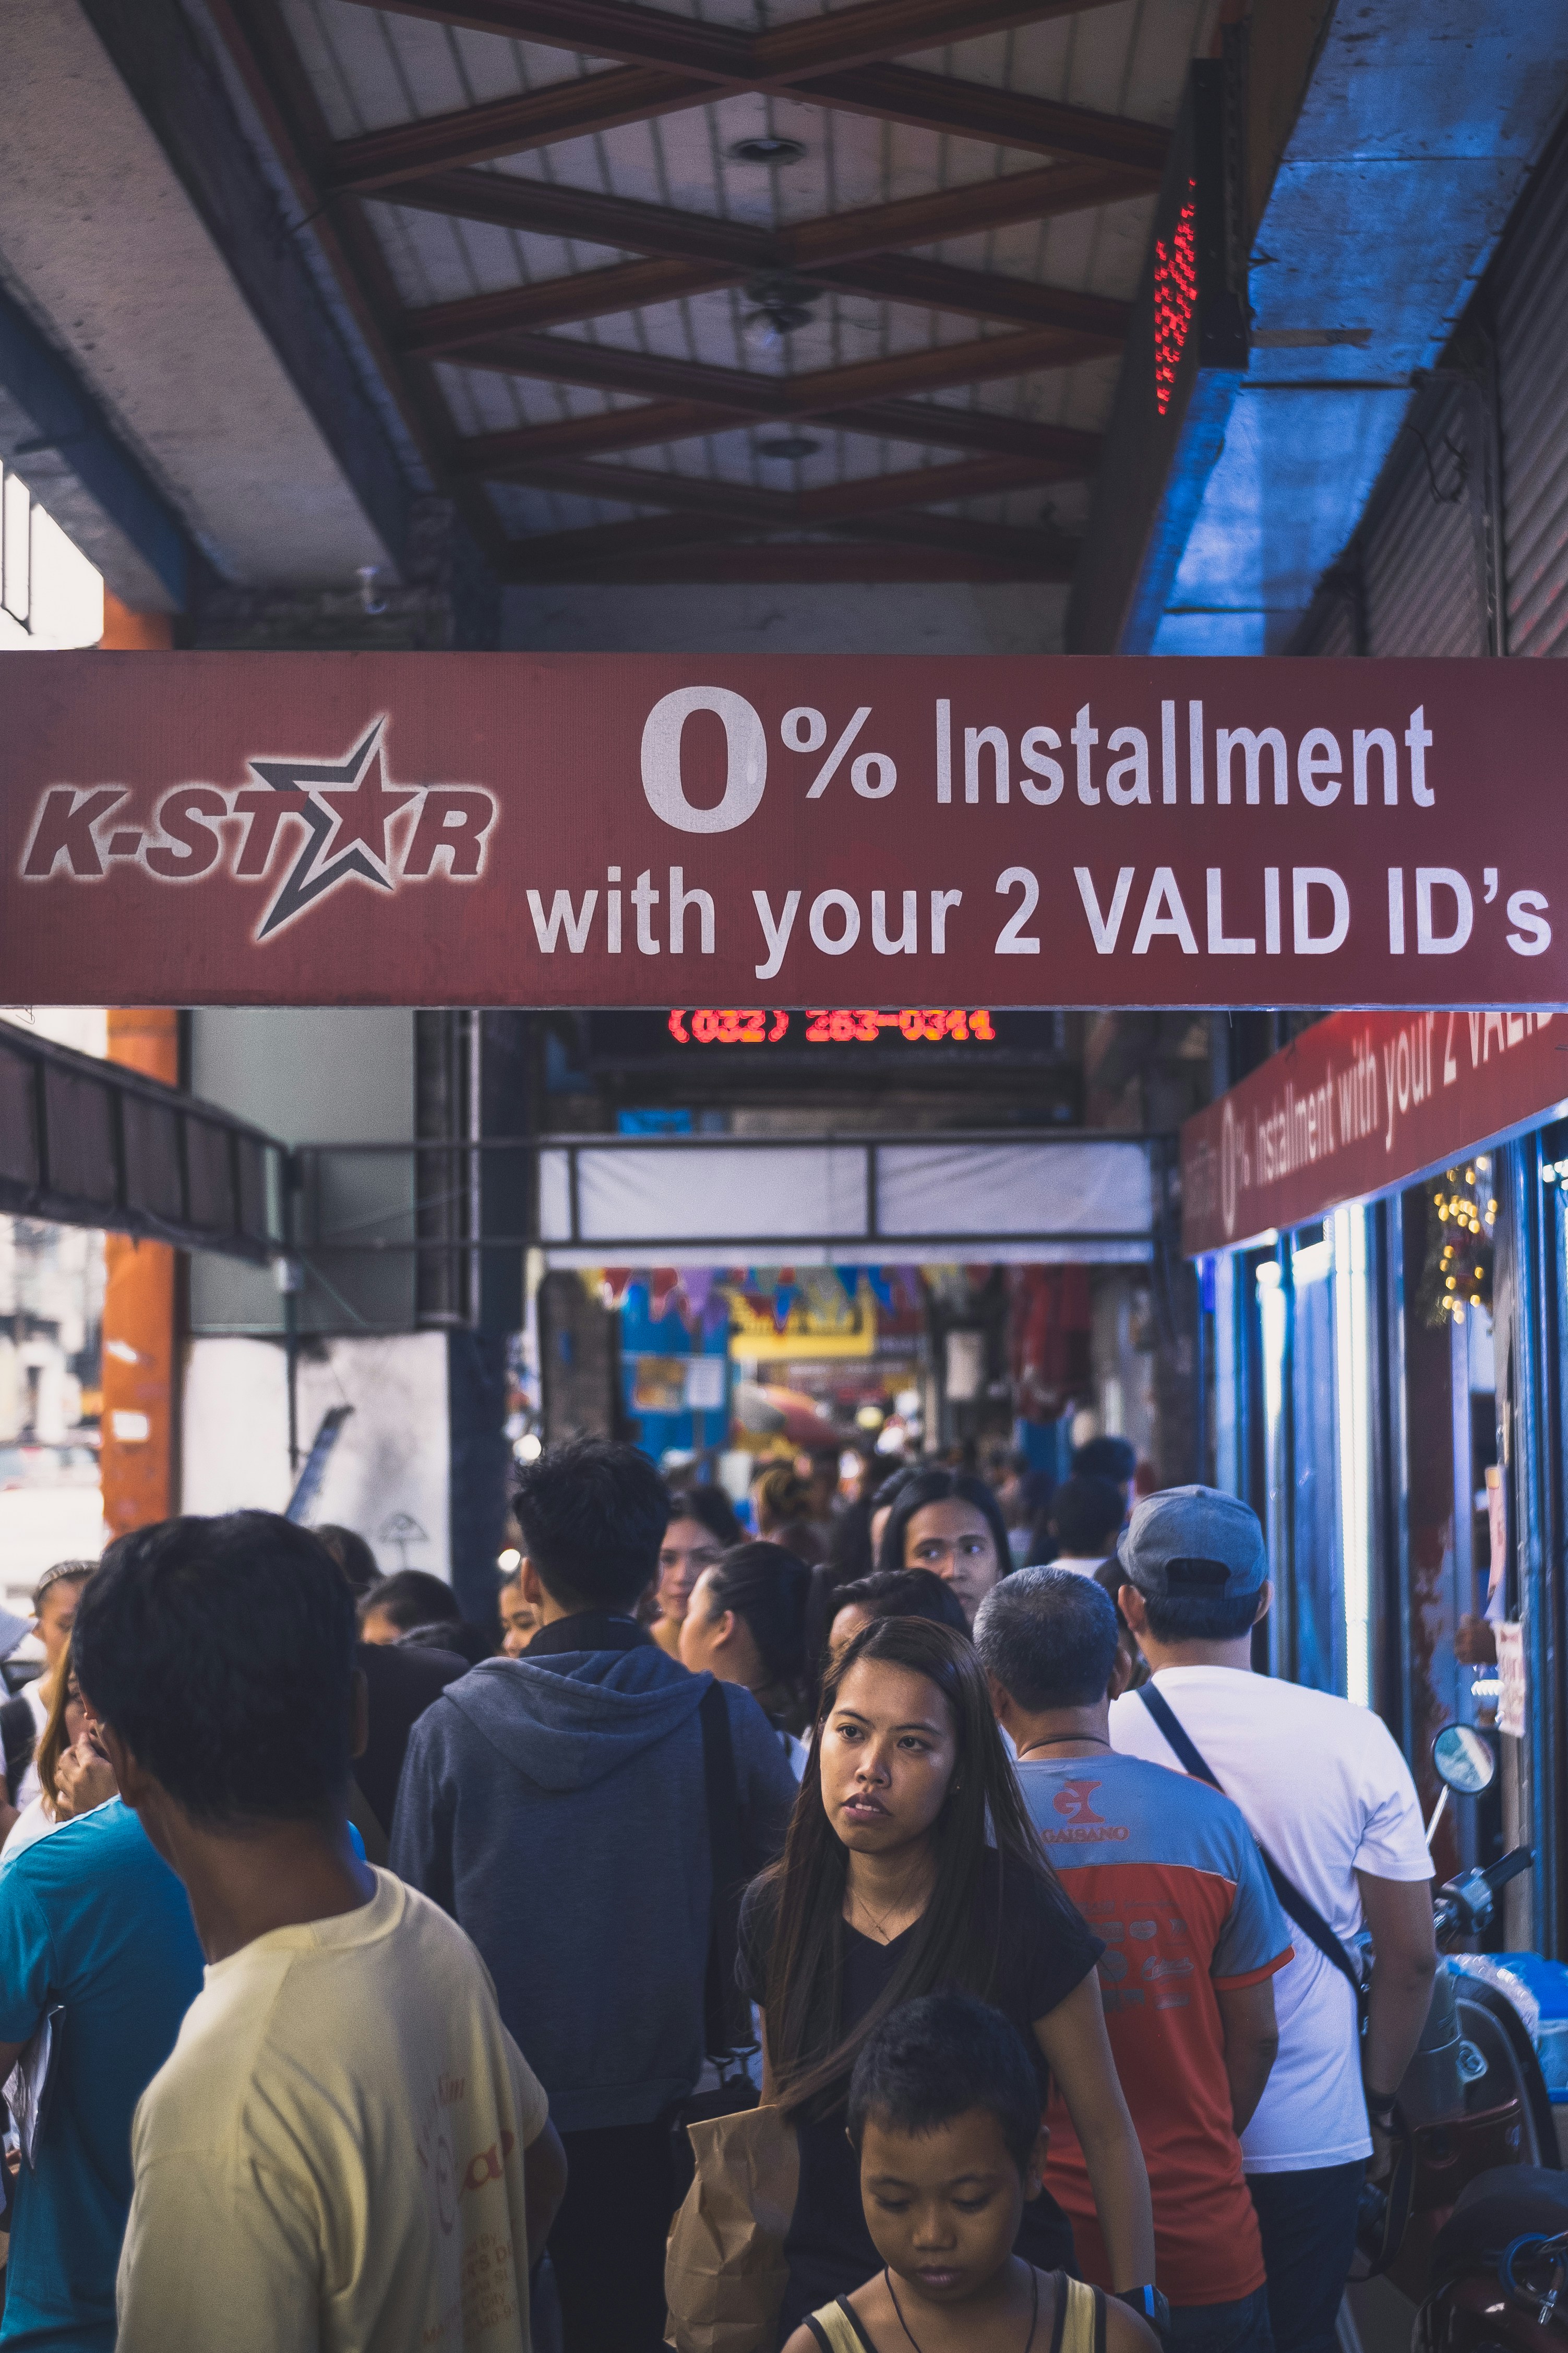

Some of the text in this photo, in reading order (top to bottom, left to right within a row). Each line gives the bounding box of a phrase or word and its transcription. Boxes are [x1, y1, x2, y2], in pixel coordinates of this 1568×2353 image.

[640, 685, 1436, 834] 0% Installment
[526, 866, 715, 955] with
[751, 888, 963, 980] your
[994, 866, 1041, 955] 2
[1073, 866, 1350, 955] VALID
[1338, 1026, 1380, 1145] with
[1384, 1012, 1434, 1154] your
